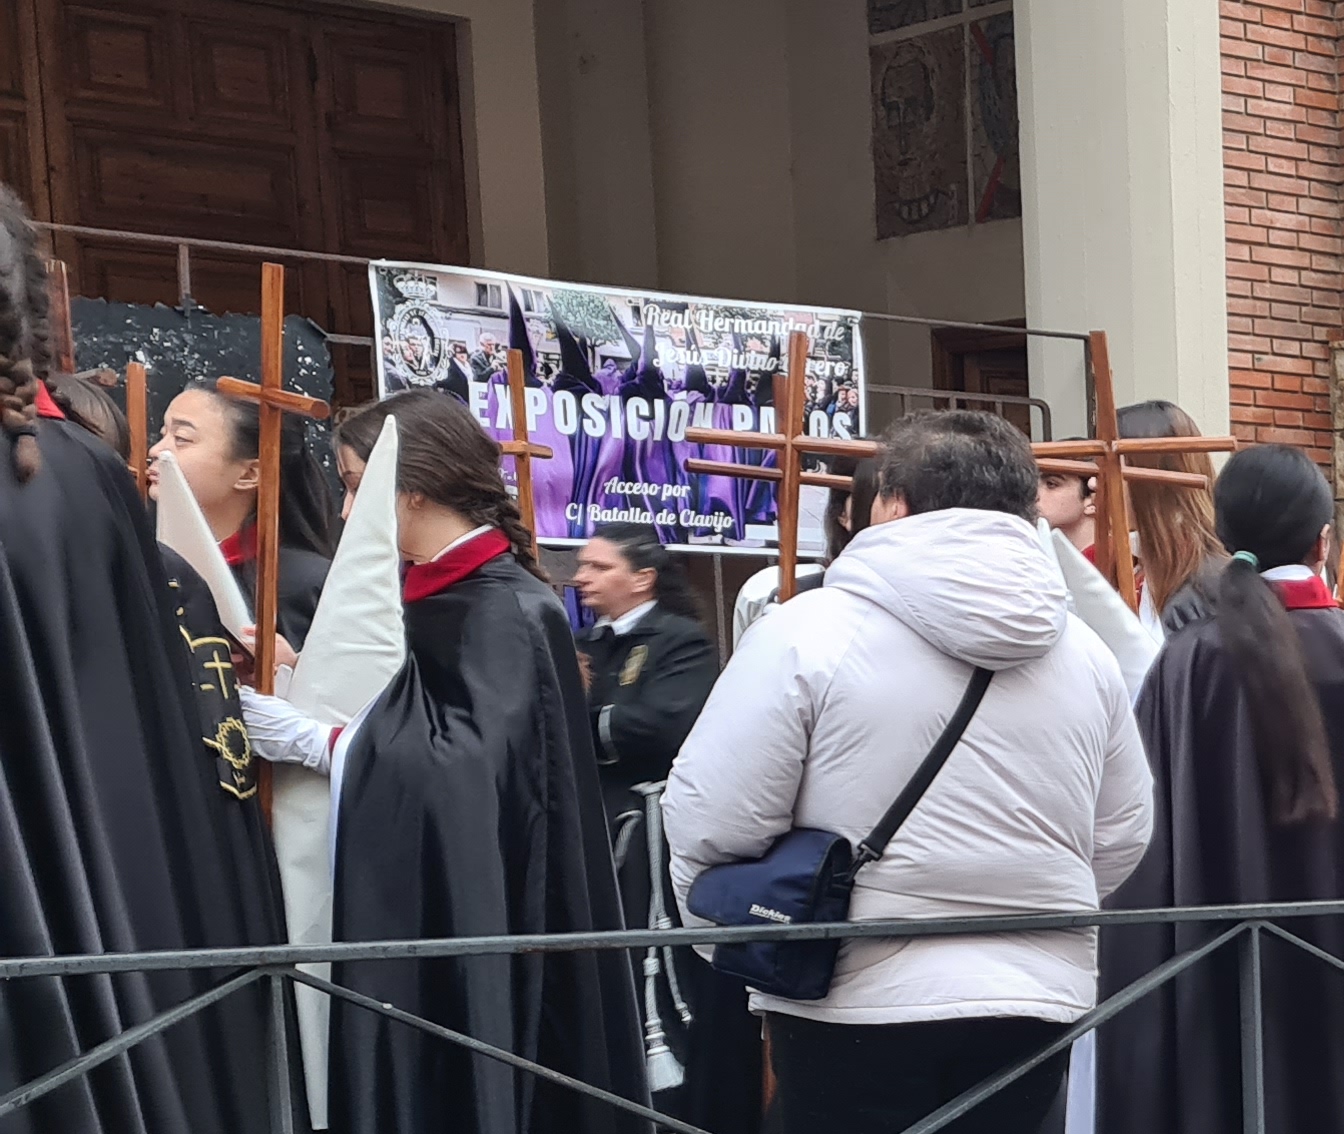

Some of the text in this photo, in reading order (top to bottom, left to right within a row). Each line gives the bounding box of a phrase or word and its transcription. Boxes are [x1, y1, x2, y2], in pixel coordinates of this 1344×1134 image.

[643, 304, 846, 341] Real Hermandad de
[653, 341, 847, 378] Jesús Divino rero
[469, 381, 715, 443] EXPOSICIÓN
[733, 404, 851, 440] PAOS
[604, 476, 691, 501] Acceso por
[588, 504, 655, 524] Batalla
[656, 509, 676, 526] de
[680, 508, 735, 533] Clavijo
[750, 903, 791, 921] Dickies
